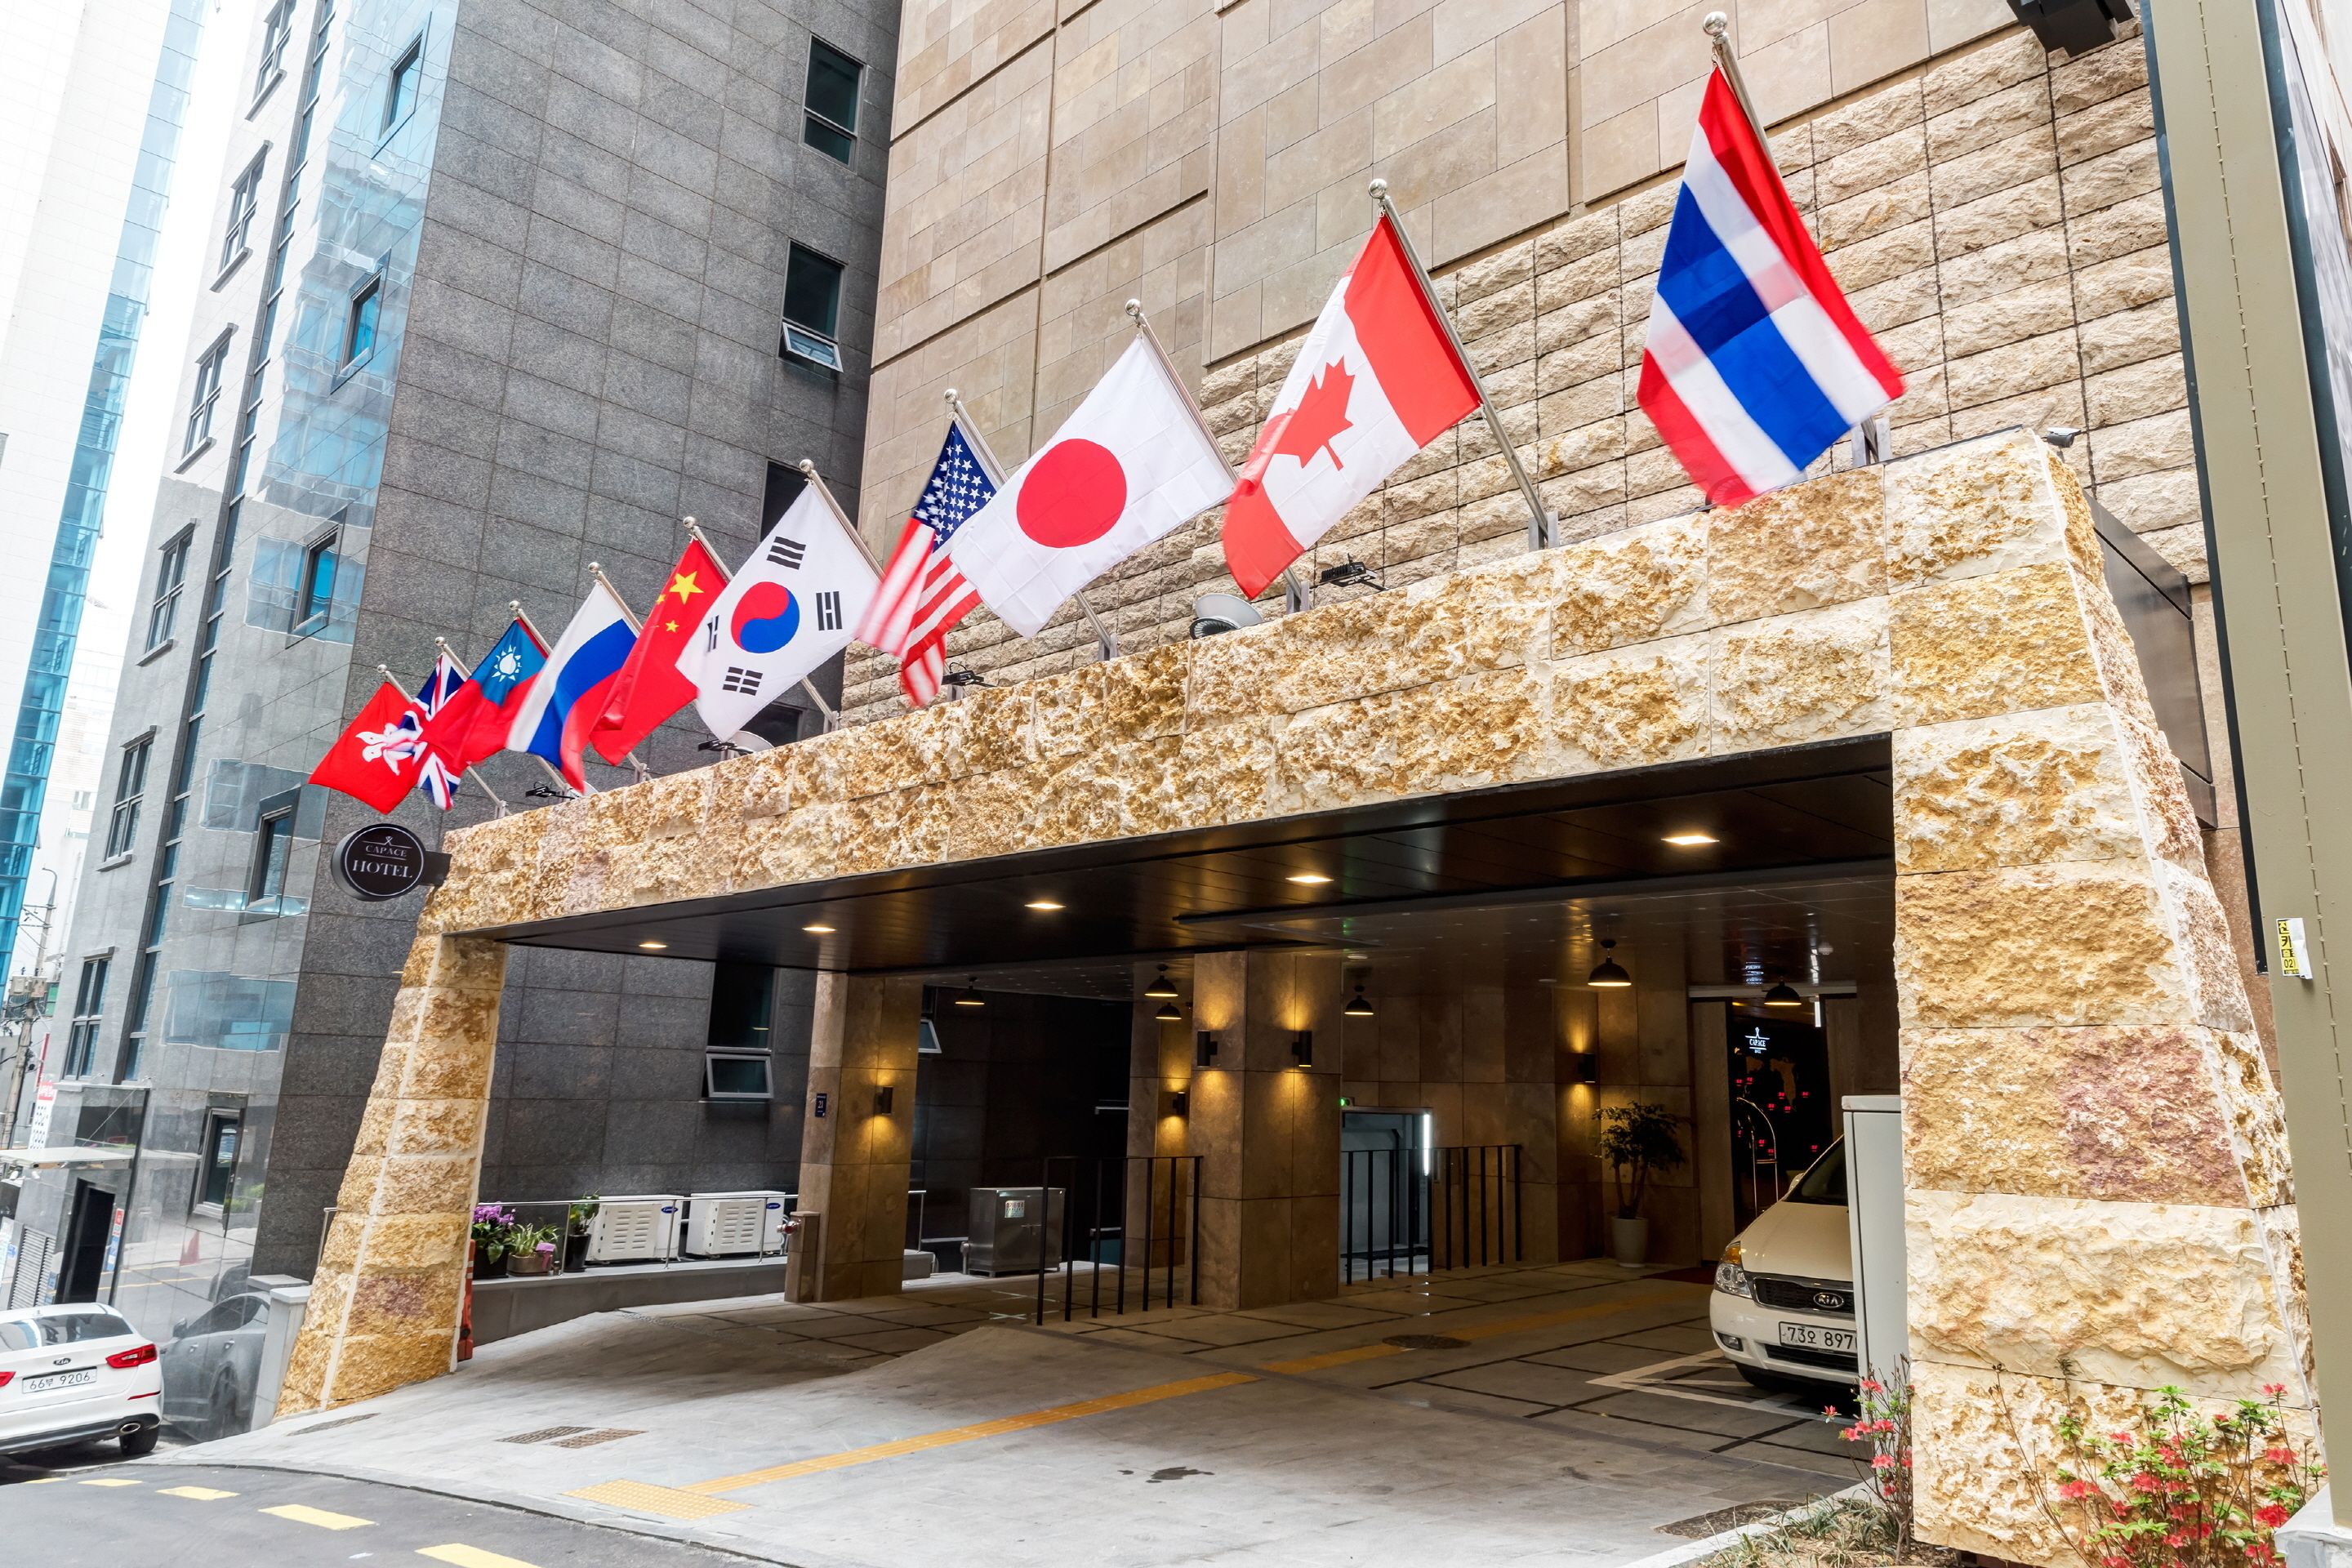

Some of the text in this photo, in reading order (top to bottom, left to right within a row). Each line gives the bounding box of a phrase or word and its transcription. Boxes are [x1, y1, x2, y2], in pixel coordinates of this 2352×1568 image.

[365, 844, 407, 858] CAPACE
[352, 859, 413, 879] HOTEL
[1817, 1294, 1839, 1306] KIA
[1787, 1326, 1858, 1350] 73오 897
[29, 1371, 91, 1391] 66부 9206
